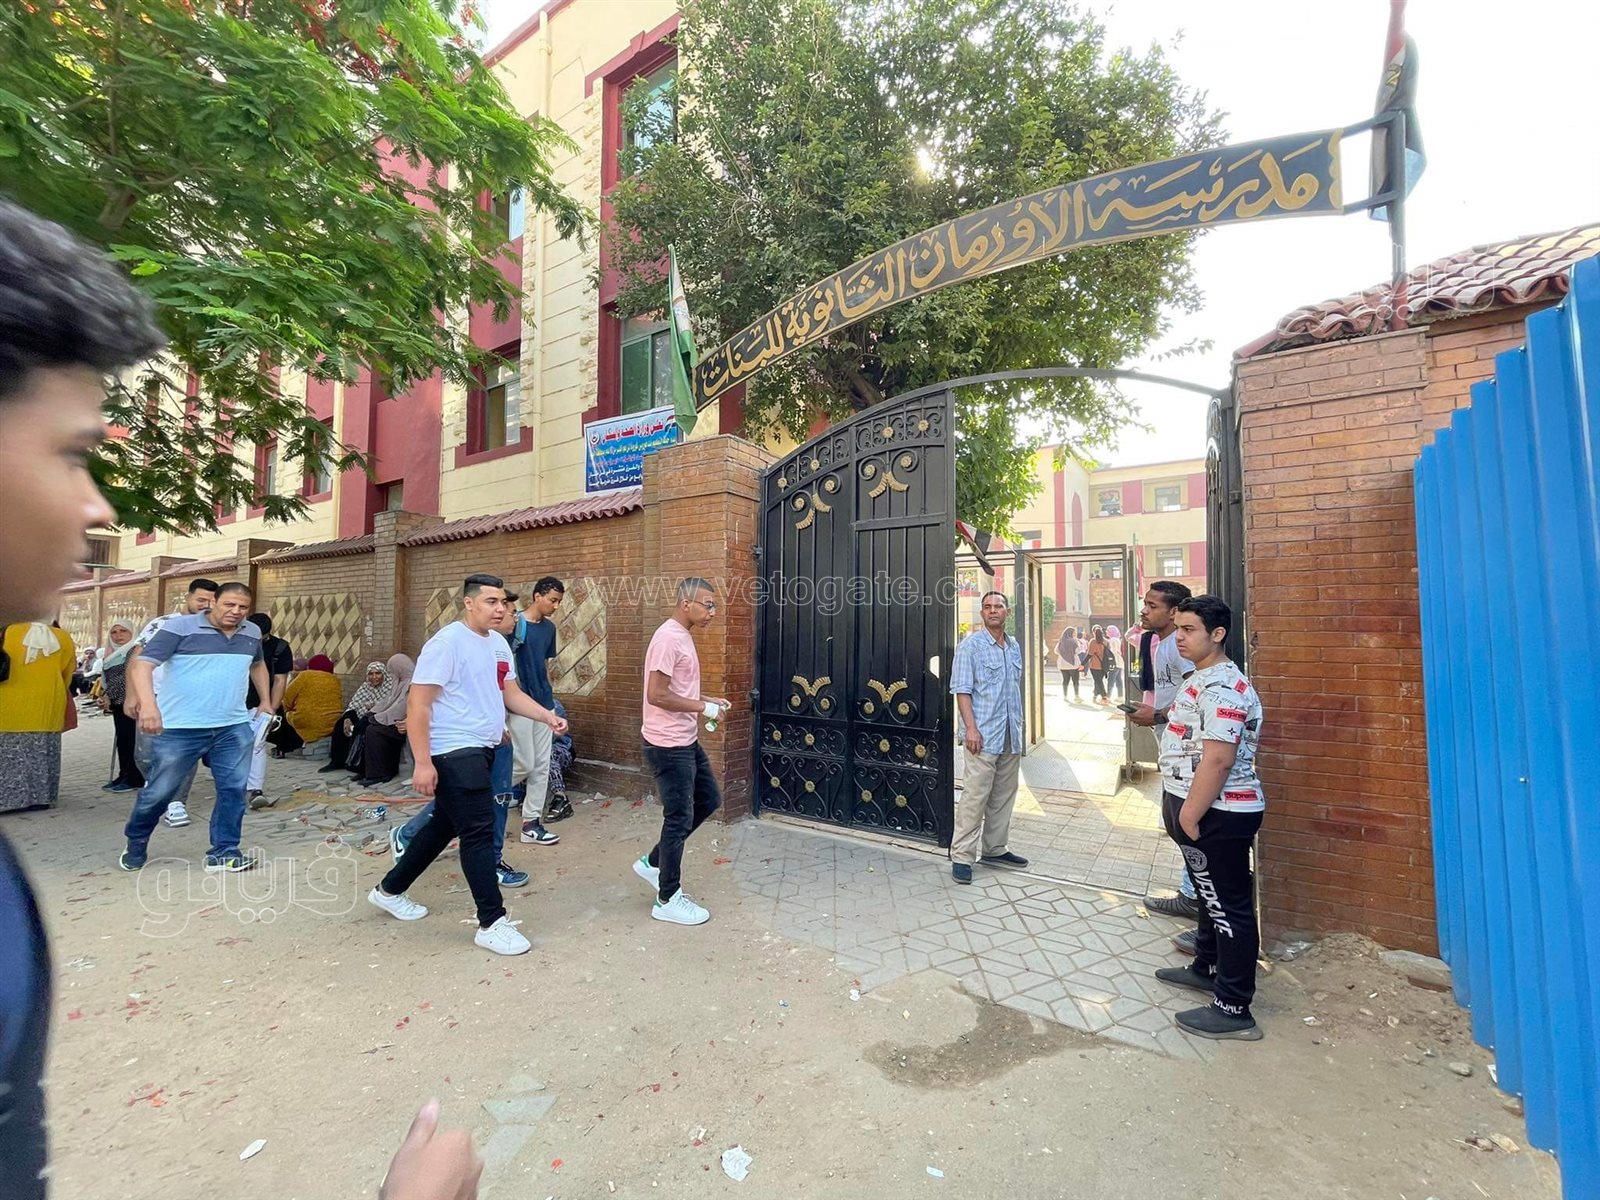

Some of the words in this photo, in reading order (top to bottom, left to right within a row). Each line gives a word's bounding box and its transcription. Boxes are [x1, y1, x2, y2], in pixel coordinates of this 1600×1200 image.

[1087, 139, 1323, 230] مدرسة
[781, 247, 907, 346] الثانوية
[701, 311, 785, 397] للبنات
